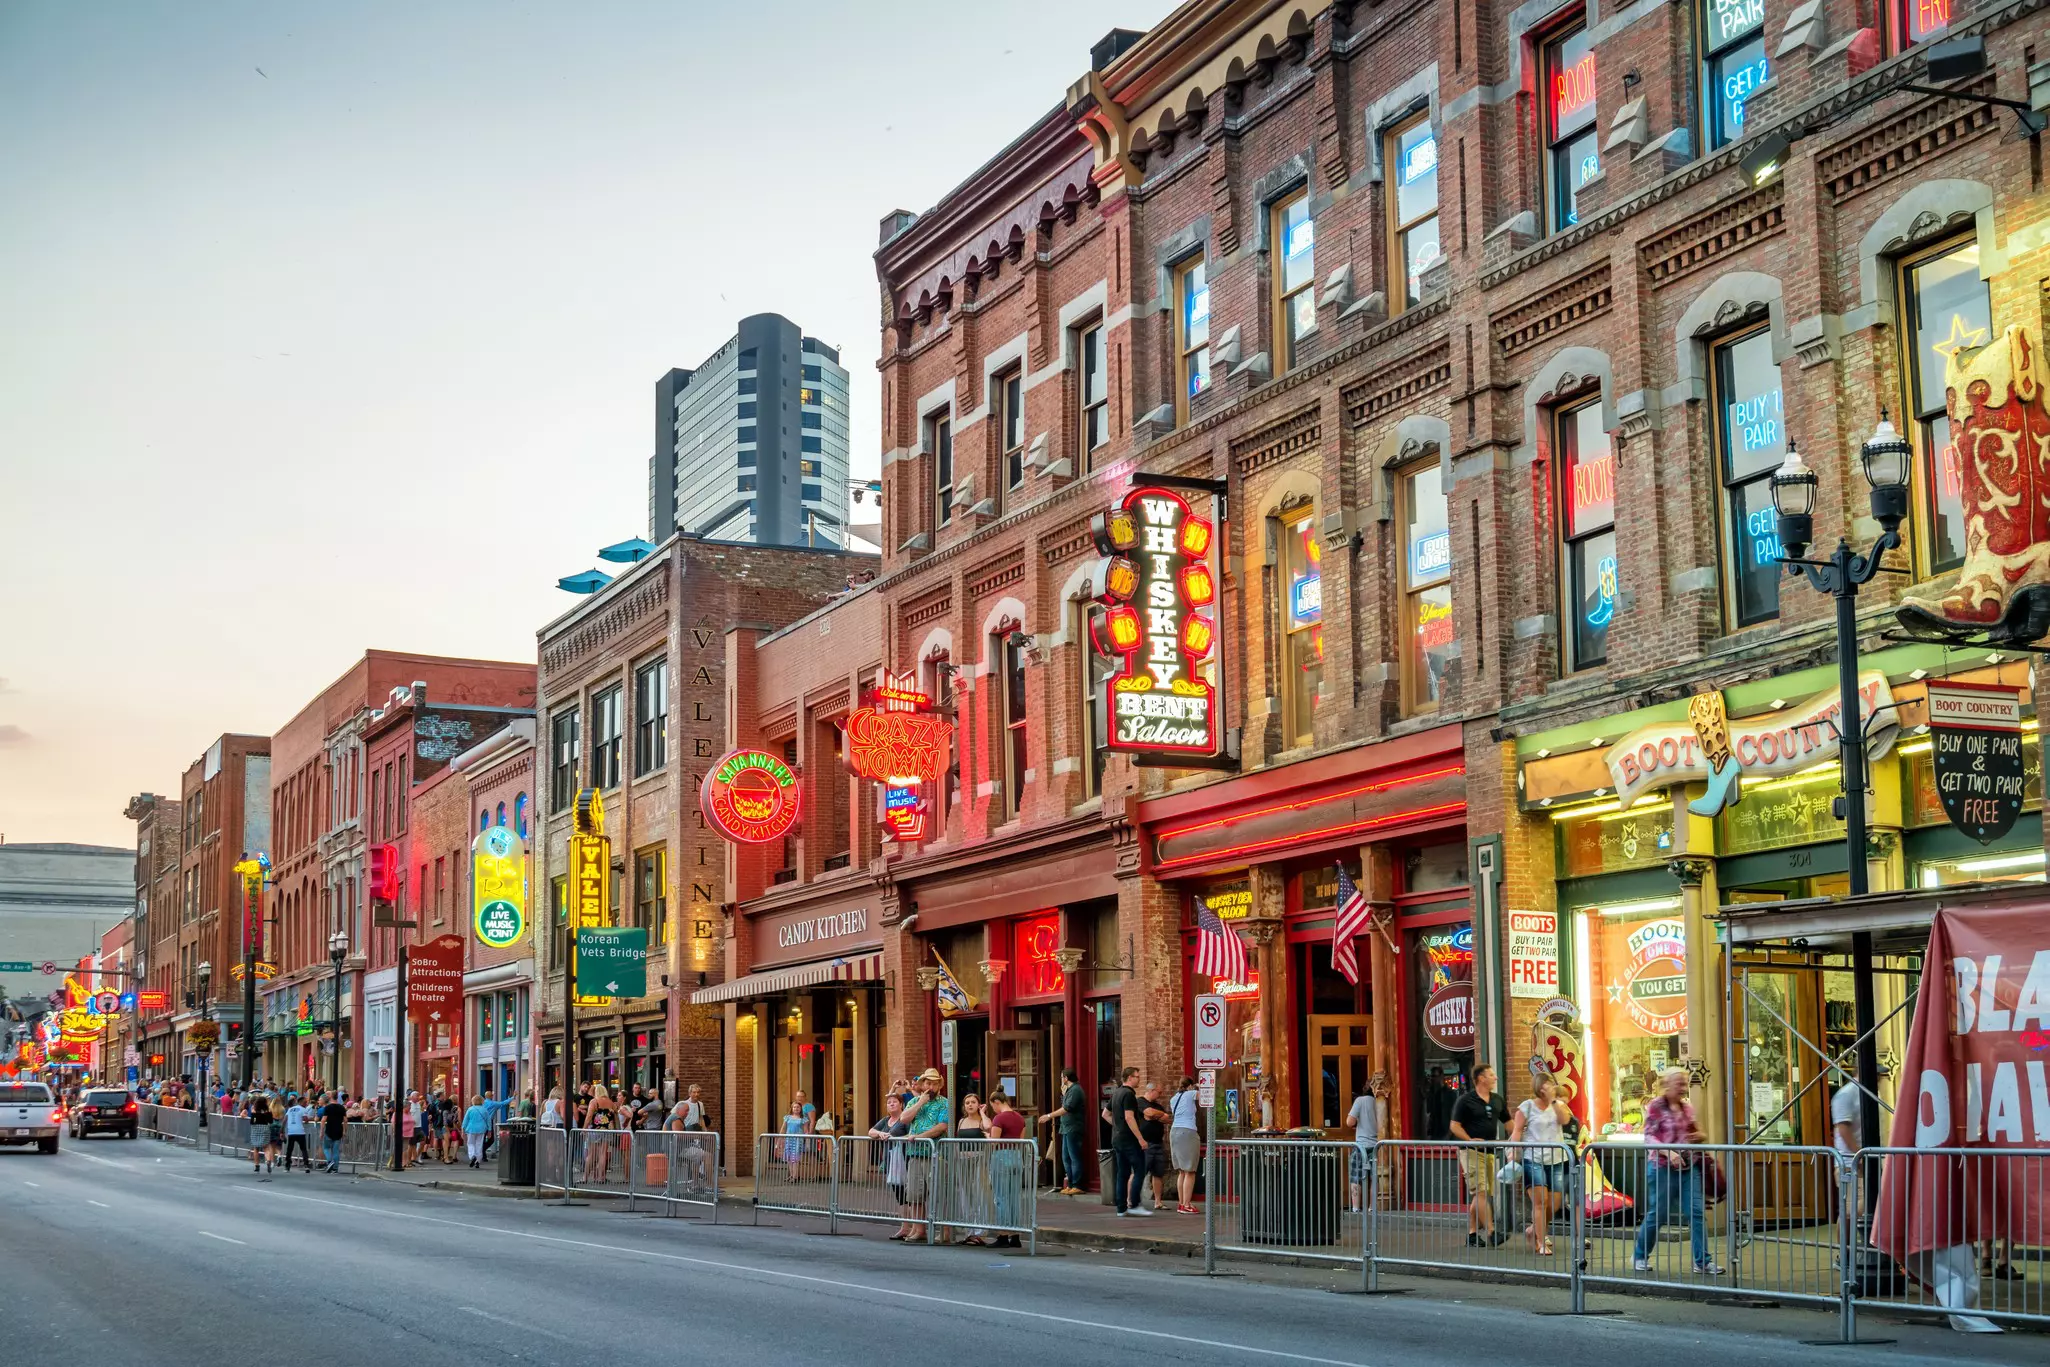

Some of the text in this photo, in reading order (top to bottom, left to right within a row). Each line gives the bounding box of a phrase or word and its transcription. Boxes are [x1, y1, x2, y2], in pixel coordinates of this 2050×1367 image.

[1725, 59, 1768, 99] GET 2
[1736, 390, 1780, 426] BUY 1
[1744, 419, 1776, 451] PAIR
[1749, 506, 1776, 536] GET
[1184, 523, 1208, 551] WB
[1420, 549, 1449, 570] LIGH
[1108, 571, 1134, 597] WB
[1142, 498, 1179, 690] WHISKEY
[1184, 573, 1210, 600] WB
[1112, 616, 1137, 643] WB
[1185, 621, 1210, 648] WB
[880, 687, 926, 703] Welcome to
[1115, 692, 1208, 722] BENT
[1935, 700, 2014, 716] BOOT COUNTRY
[848, 707, 954, 749] CRAZY
[1117, 715, 1209, 746] Saloon
[1618, 680, 1880, 786] BOOT COUNTY
[1939, 733, 2019, 758] BUY ONE PAIR
[716, 753, 794, 787] SAVANNAH'S
[851, 745, 941, 781] TOWN
[1971, 755, 1986, 771] &
[1940, 771, 2023, 797] GET TWO PAIR
[715, 798, 749, 836] CANDY
[752, 800, 795, 838] KITCHEN
[1963, 799, 2000, 825] FREE
[583, 835, 600, 845] the
[1788, 851, 1812, 868] 304
[490, 910, 510, 920] LIVE
[496, 902, 505, 911] A
[1217, 905, 1248, 919] SALOON
[485, 919, 516, 929] MUSIC
[487, 929, 514, 939] JOINT
[779, 909, 867, 948] CANDY KITCHEN
[1513, 915, 1554, 932] BOOTS
[580, 934, 620, 945] Korean
[1515, 936, 1530, 945] BUY
[1537, 936, 1553, 946] PAIR
[1629, 922, 1686, 953] BOOT
[411, 958, 438, 968] SoBro
[581, 947, 646, 960] Vets Bridge
[1511, 945, 1557, 957] GET TWO PAIR
[411, 968, 462, 979] Attractions
[1511, 959, 1558, 985] FREE
[1624, 955, 1644, 981] BUY
[411, 983, 454, 993] Childrens
[411, 993, 446, 1003] Theatre
[1638, 977, 1686, 996] YOU GET
[1429, 996, 1468, 1027] WHISKEY
[1625, 1000, 1677, 1033] TWO PAIR
[1441, 1025, 1475, 1036] SALOO
